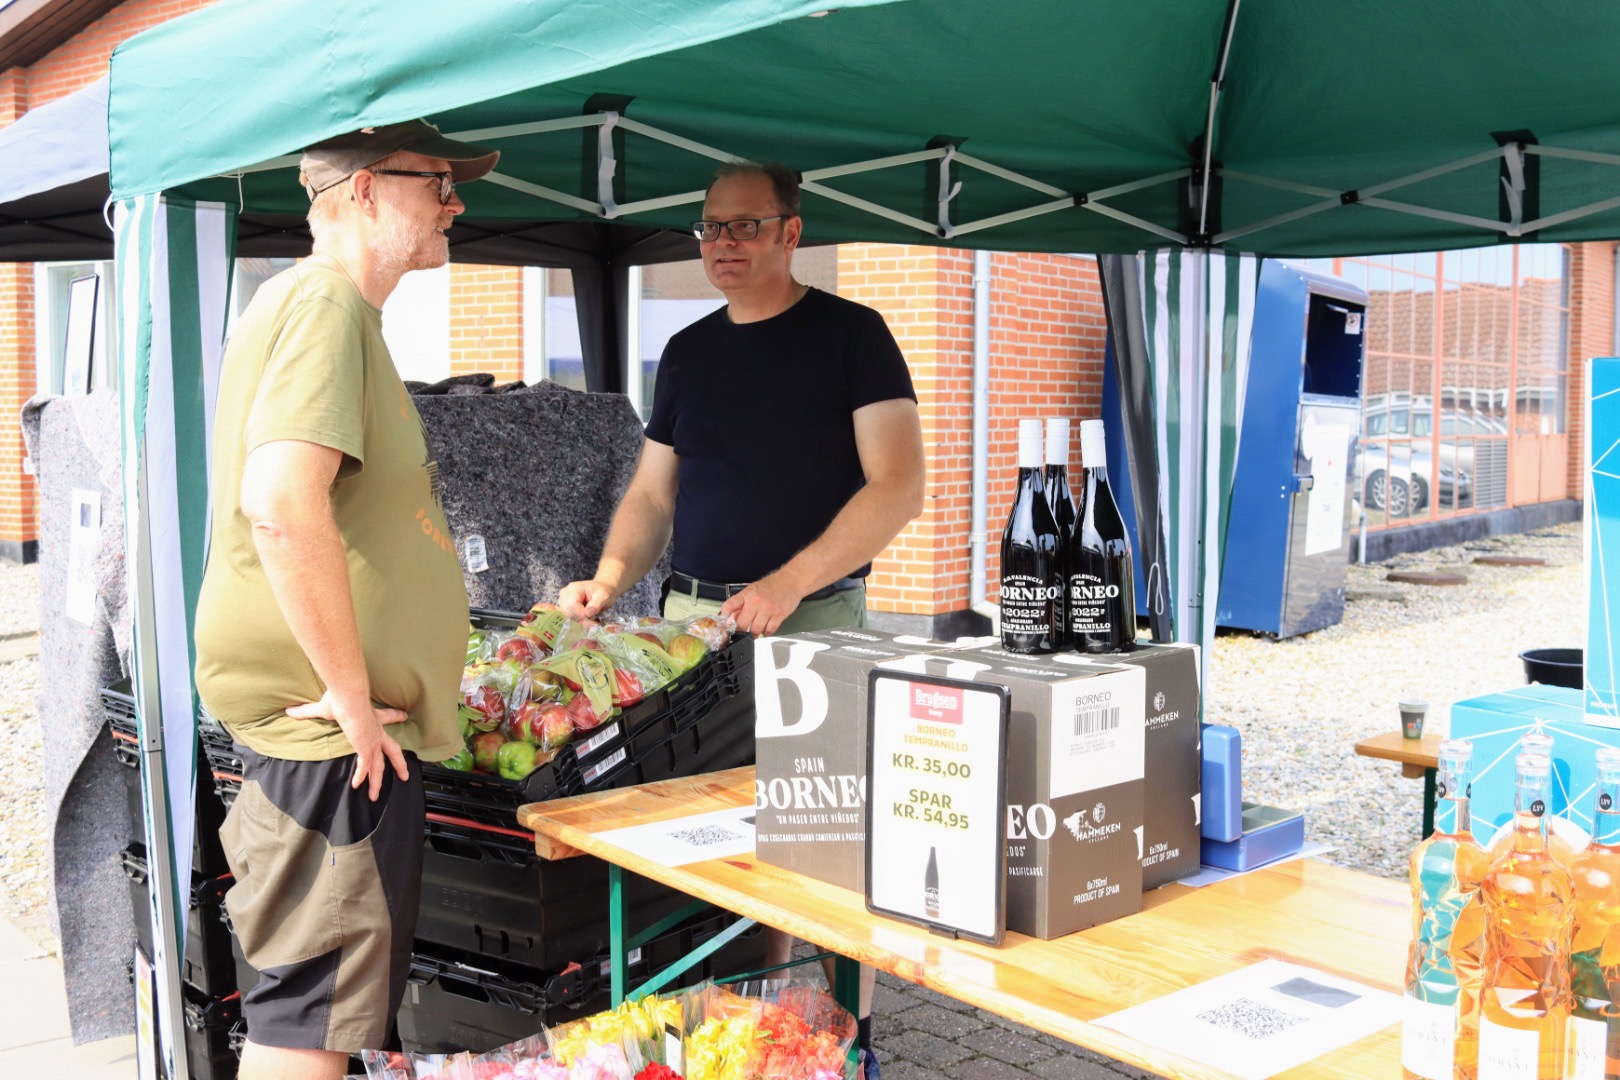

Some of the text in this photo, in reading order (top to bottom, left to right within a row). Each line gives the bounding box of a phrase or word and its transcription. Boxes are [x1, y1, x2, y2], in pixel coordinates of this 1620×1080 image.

[1000, 584, 1057, 601] ORNEO
[1070, 584, 1120, 599] RNEO
[915, 688, 958, 710] Brugsen
[1075, 691, 1112, 707] BORNEO
[1145, 710, 1180, 727] AMMEKEN
[916, 724, 957, 738] BORNEO
[903, 735, 970, 753] TEMPRANILLO
[794, 757, 826, 773] SPAIN
[892, 753, 972, 779] KR. 35,00
[909, 788, 953, 810] SPAR
[788, 814, 808, 825] PASEO
[809, 813, 830, 825] ENTRE
[893, 802, 970, 830] KR. 54,95
[1076, 822, 1122, 843] HAMMEKEN
[1159, 851, 1166, 861] OF
[1166, 847, 1181, 860] SPAIN
[1073, 883, 1121, 905] PRODUCT OF SPAIN
